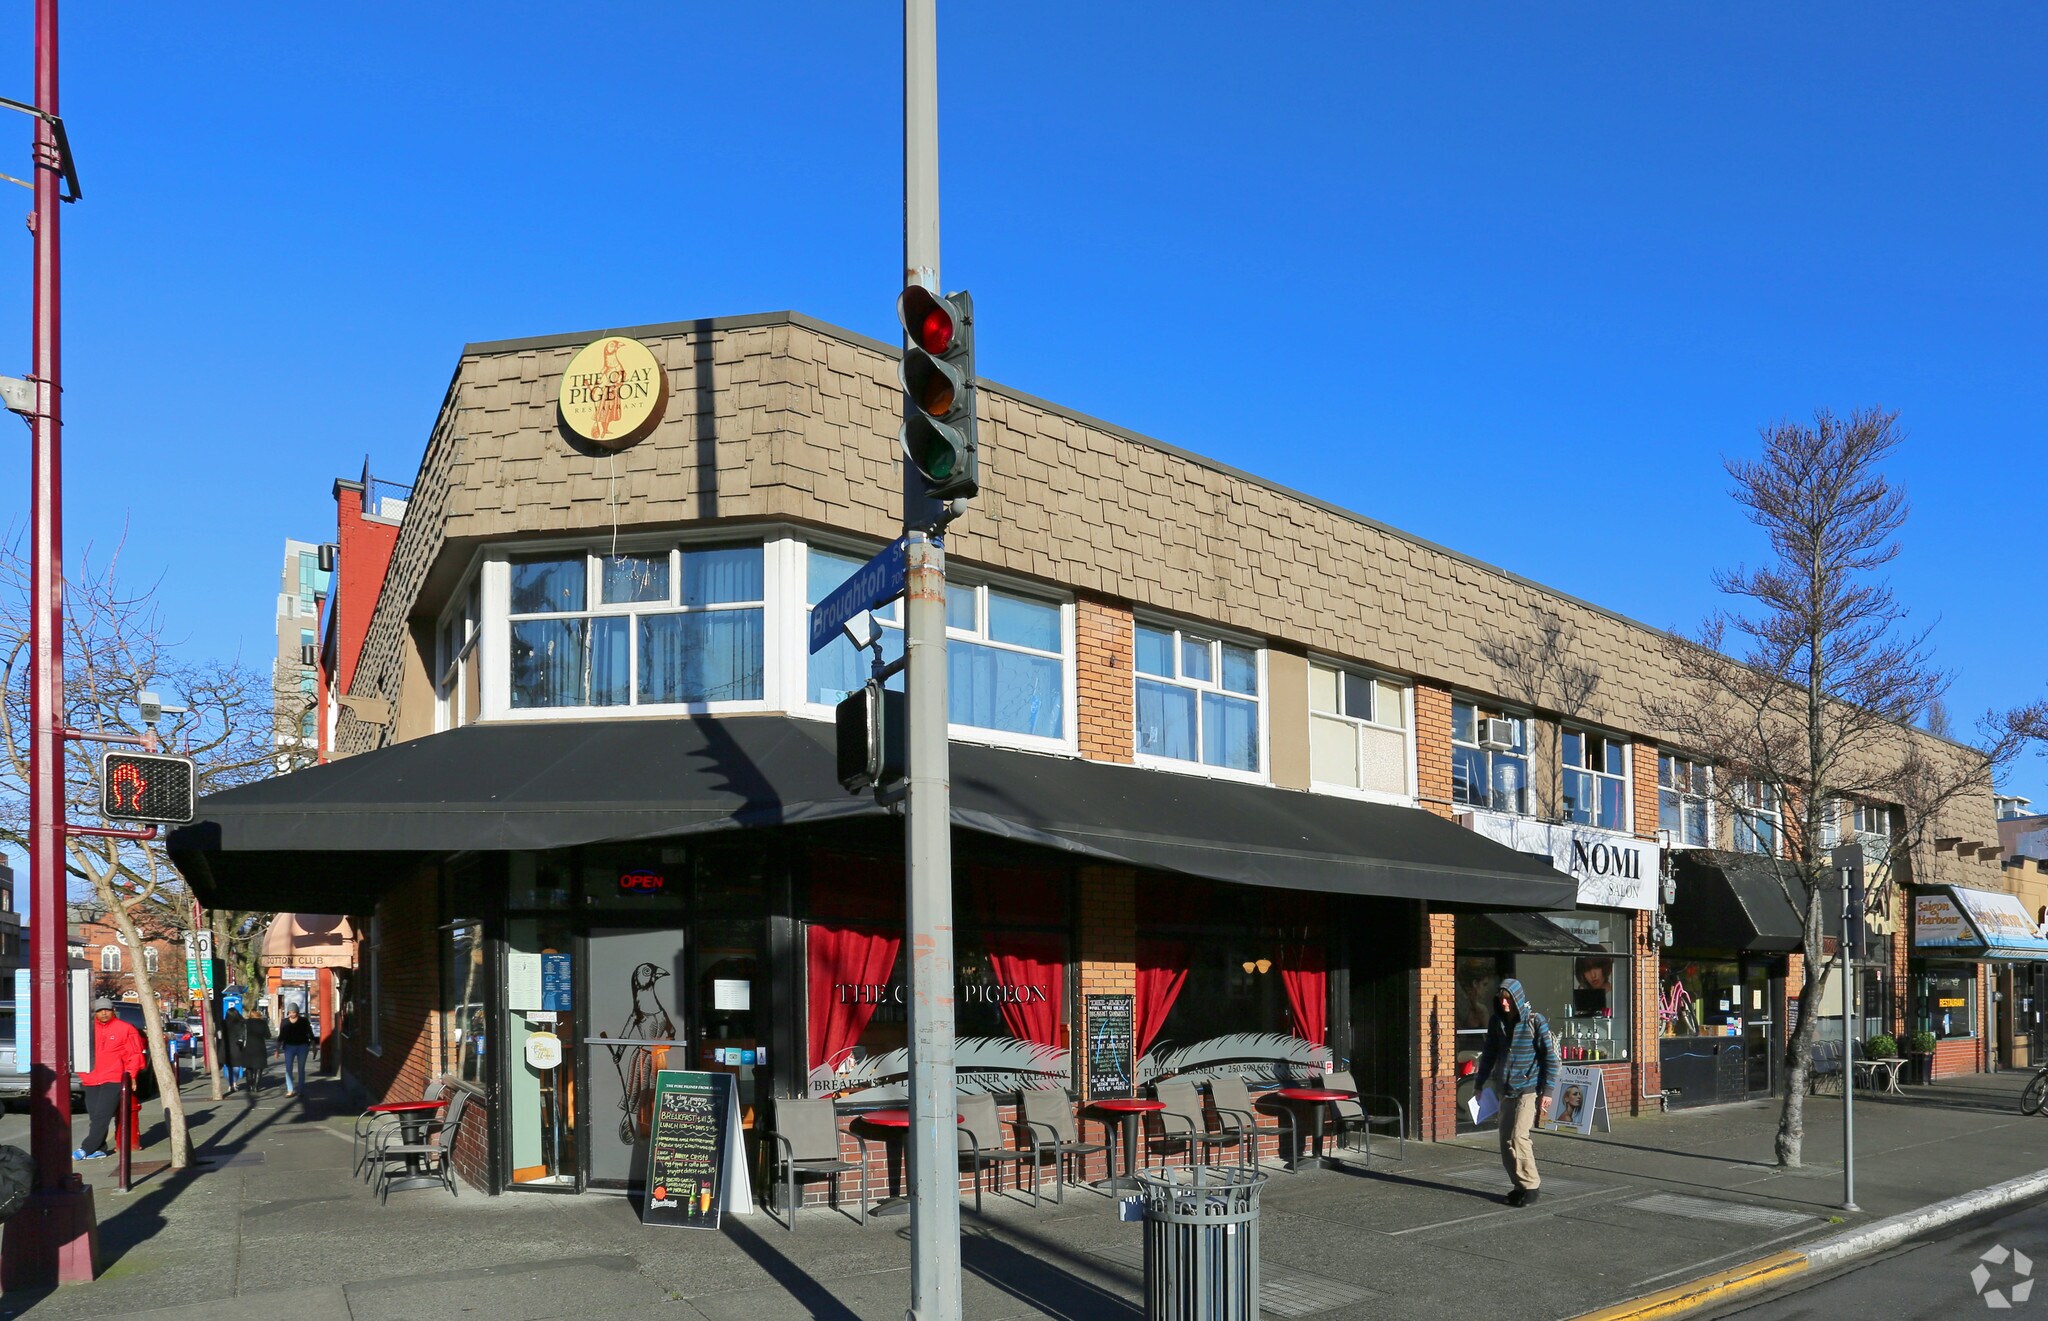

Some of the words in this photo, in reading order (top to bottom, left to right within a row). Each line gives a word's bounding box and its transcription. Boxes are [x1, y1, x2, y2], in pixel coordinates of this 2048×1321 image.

[570, 372, 604, 388] THE
[608, 367, 652, 384] CLAY
[568, 381, 650, 405] PIGEON
[574, 402, 644, 414] RESTAURANT
[812, 563, 886, 640] Broughton
[1571, 839, 1641, 880] NOMI
[620, 874, 664, 888] OPEN
[1608, 882, 1640, 899] SALON
[1917, 900, 1950, 916] Saigon
[1917, 912, 1960, 925] Harbour
[298, 956, 324, 965] CLUB
[835, 984, 888, 1004] THE
[964, 984, 1048, 1004] PIGEON
[1290, 1060, 1325, 1070] AKEAWAY
[1565, 1066, 1589, 1077] NOMI
[955, 1073, 1001, 1085] DINNER
[1012, 1069, 1068, 1082] TAKEAWAY
[661, 1111, 696, 1122] BREAKFAST
